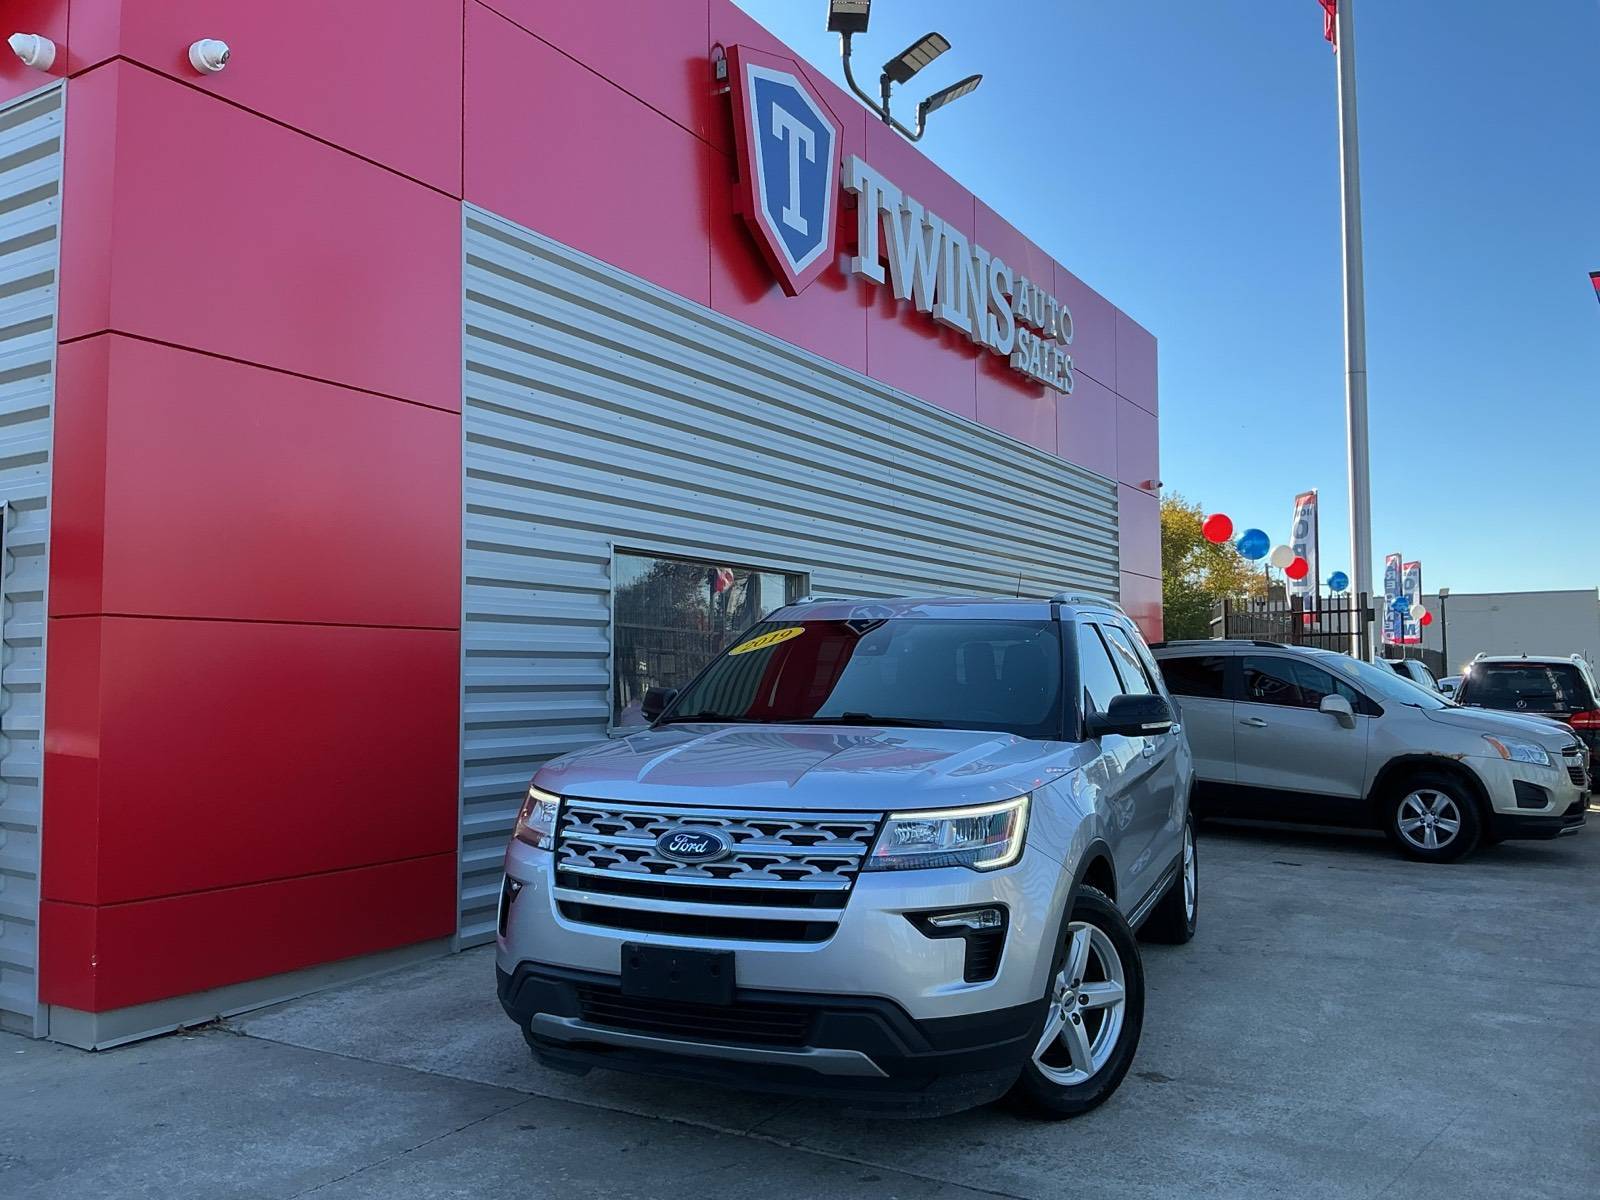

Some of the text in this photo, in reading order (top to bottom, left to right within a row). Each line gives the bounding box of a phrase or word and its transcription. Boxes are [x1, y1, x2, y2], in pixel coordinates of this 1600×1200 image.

[772, 101, 816, 237] T
[844, 154, 1016, 356] TWINS
[1013, 275, 1074, 346] AUTO
[1010, 327, 1074, 395] SALES
[739, 629, 794, 653] 2019
[669, 833, 709, 853] Ford
